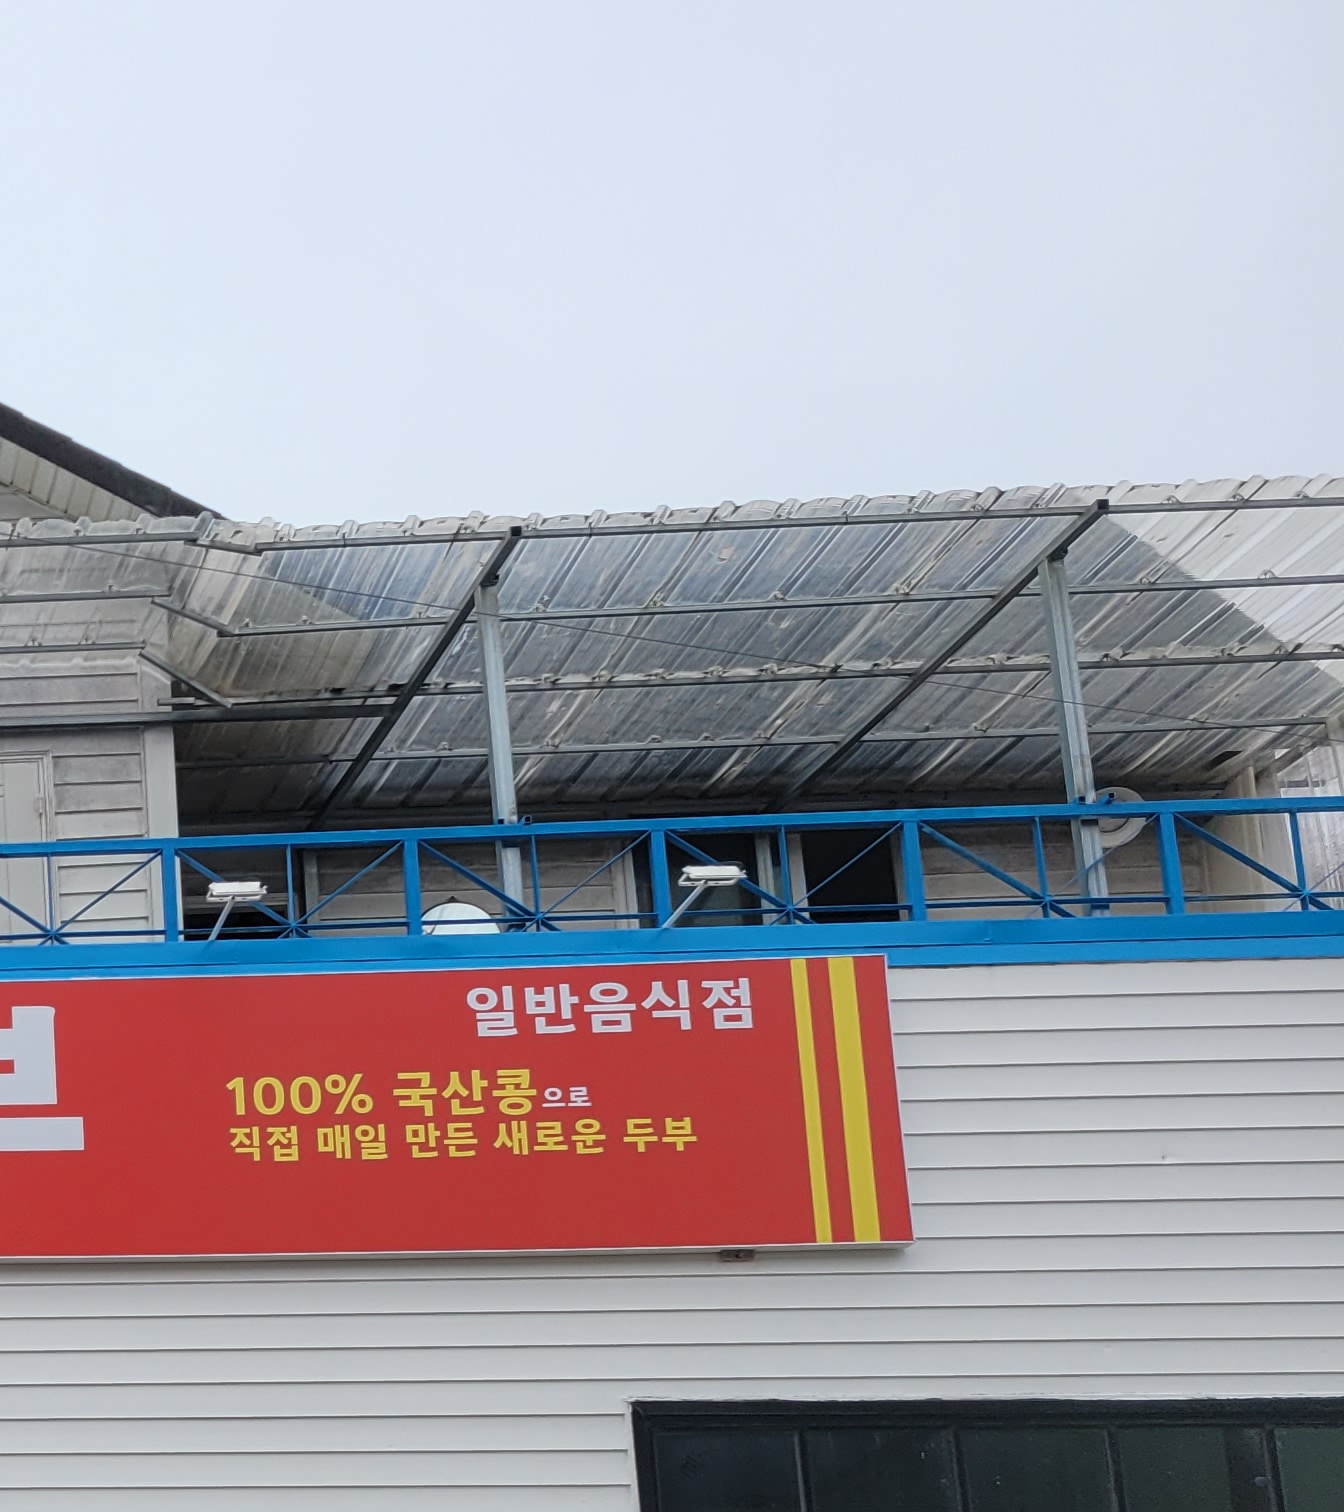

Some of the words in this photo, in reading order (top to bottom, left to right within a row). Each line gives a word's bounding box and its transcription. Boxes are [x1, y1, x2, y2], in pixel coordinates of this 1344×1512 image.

[466, 977, 753, 1037] 일반음식점
[225, 1073, 374, 1116] 100%
[392, 1068, 592, 1117] 국산콩으로
[229, 1126, 299, 1162] 직접
[316, 1123, 388, 1160] 매일
[405, 1122, 478, 1158] 만든
[493, 1117, 606, 1155] 새로운
[623, 1116, 698, 1152] 두부
